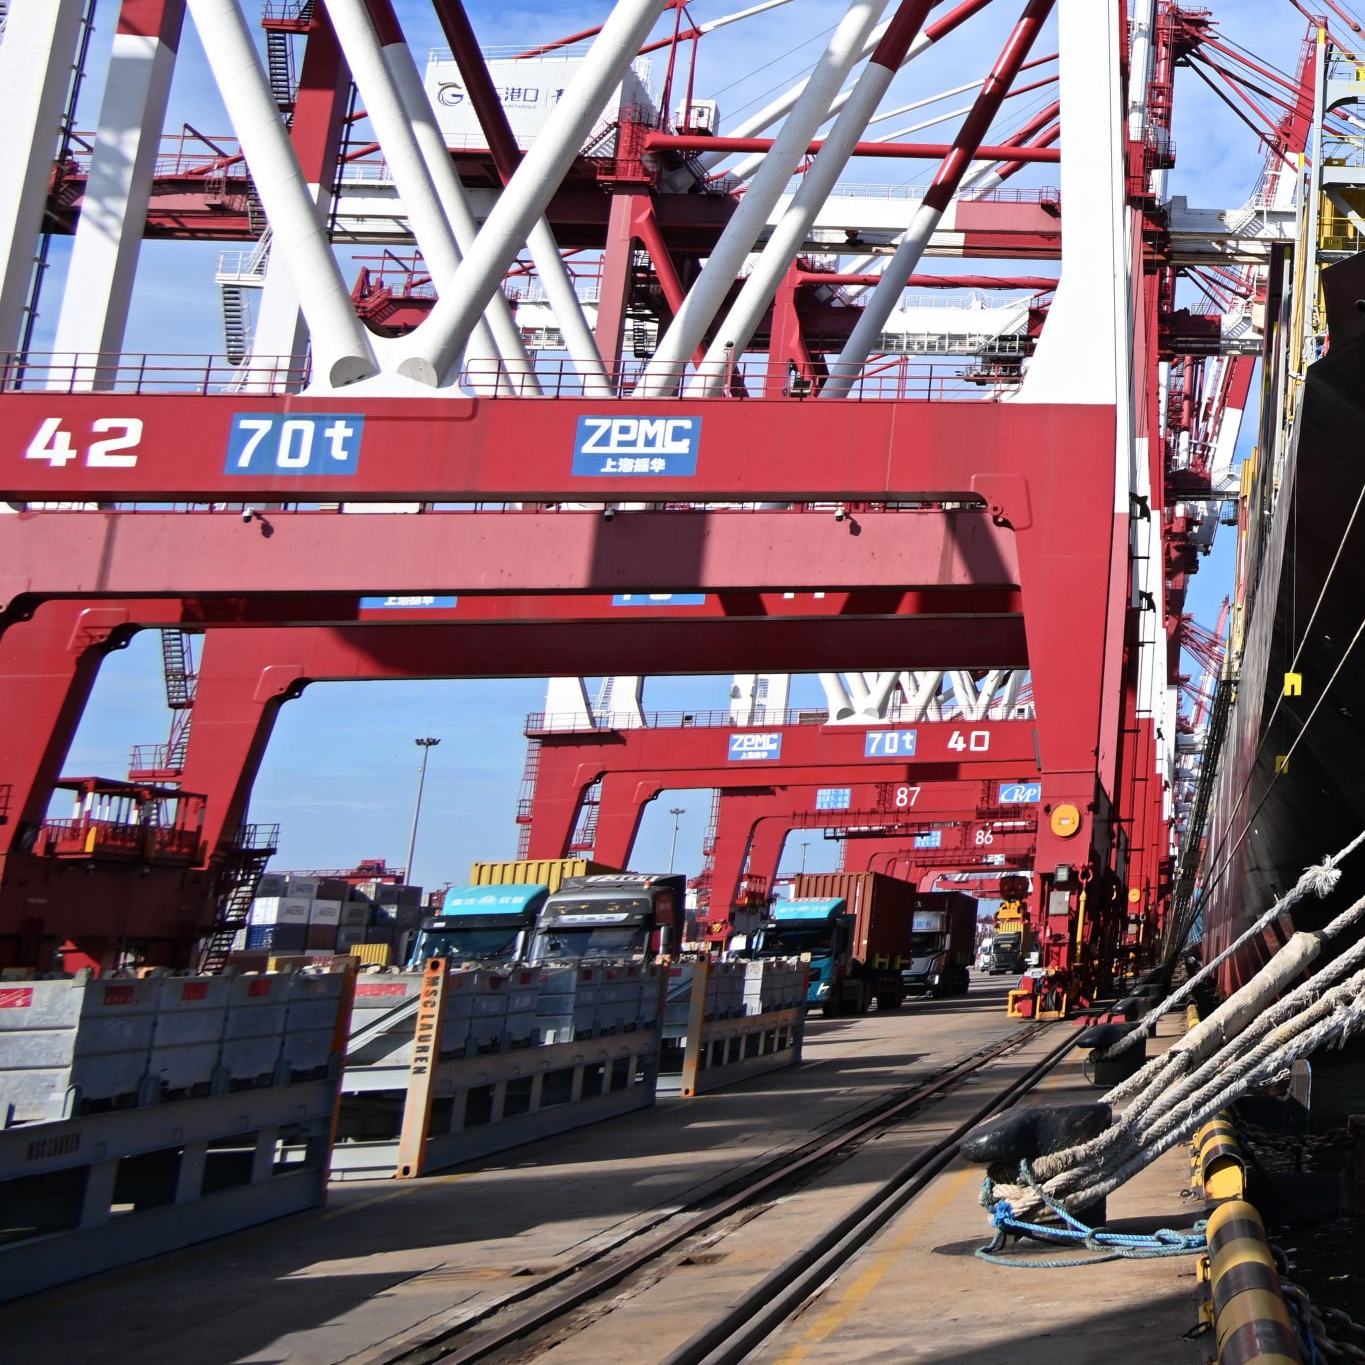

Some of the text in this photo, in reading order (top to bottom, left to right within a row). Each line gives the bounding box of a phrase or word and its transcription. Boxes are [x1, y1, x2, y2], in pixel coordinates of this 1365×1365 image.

[24, 417, 144, 468] 42
[580, 418, 693, 454] ZPMC
[600, 457, 666, 473] 上海振华
[731, 734, 778, 751] ZPMC
[947, 730, 990, 752] 40
[895, 786, 921, 808] 87
[975, 829, 994, 845] 86
[412, 976, 440, 1075] MSC LAUREN
